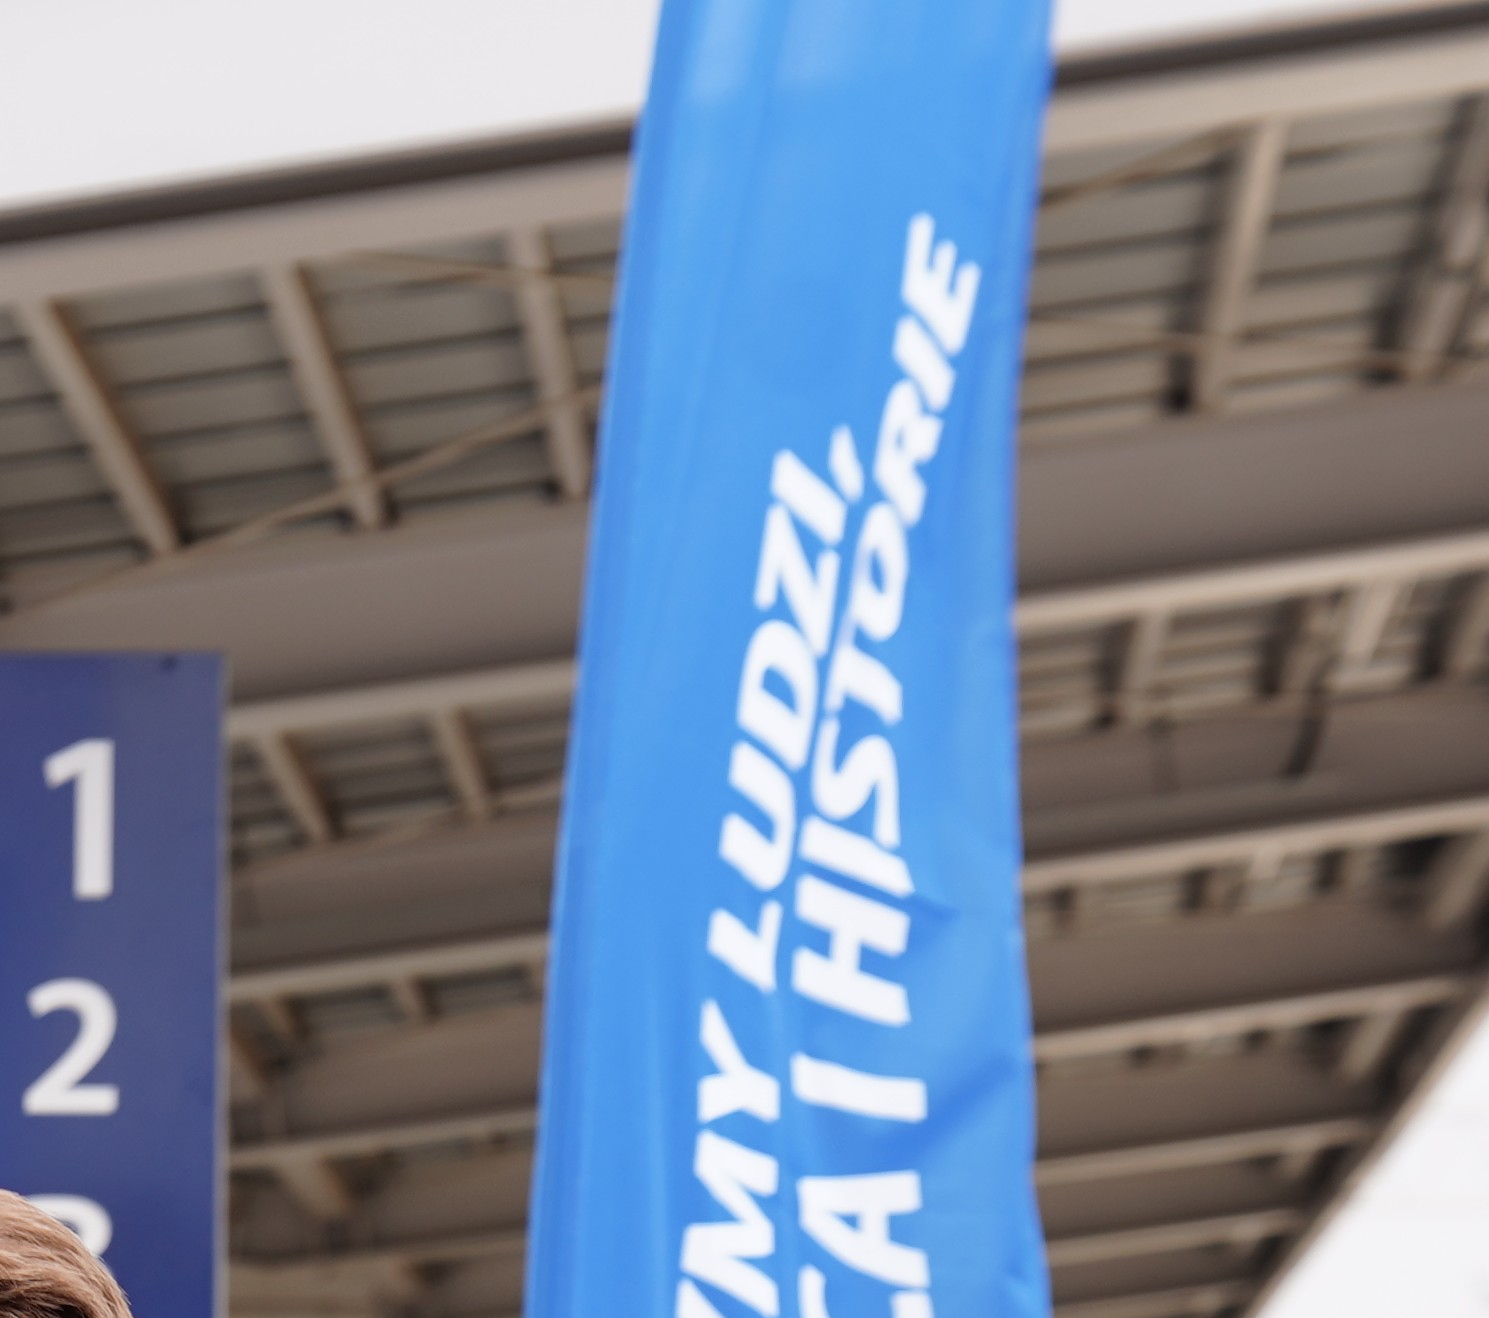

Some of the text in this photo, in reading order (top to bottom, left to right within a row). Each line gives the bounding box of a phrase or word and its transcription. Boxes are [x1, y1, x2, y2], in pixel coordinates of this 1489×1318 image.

[791, 213, 981, 1027] HISTORIE
[707, 426, 865, 992] LUDZI,
[44, 738, 114, 900] 1
[23, 978, 119, 1116] 2
[790, 1053, 927, 1122] I
